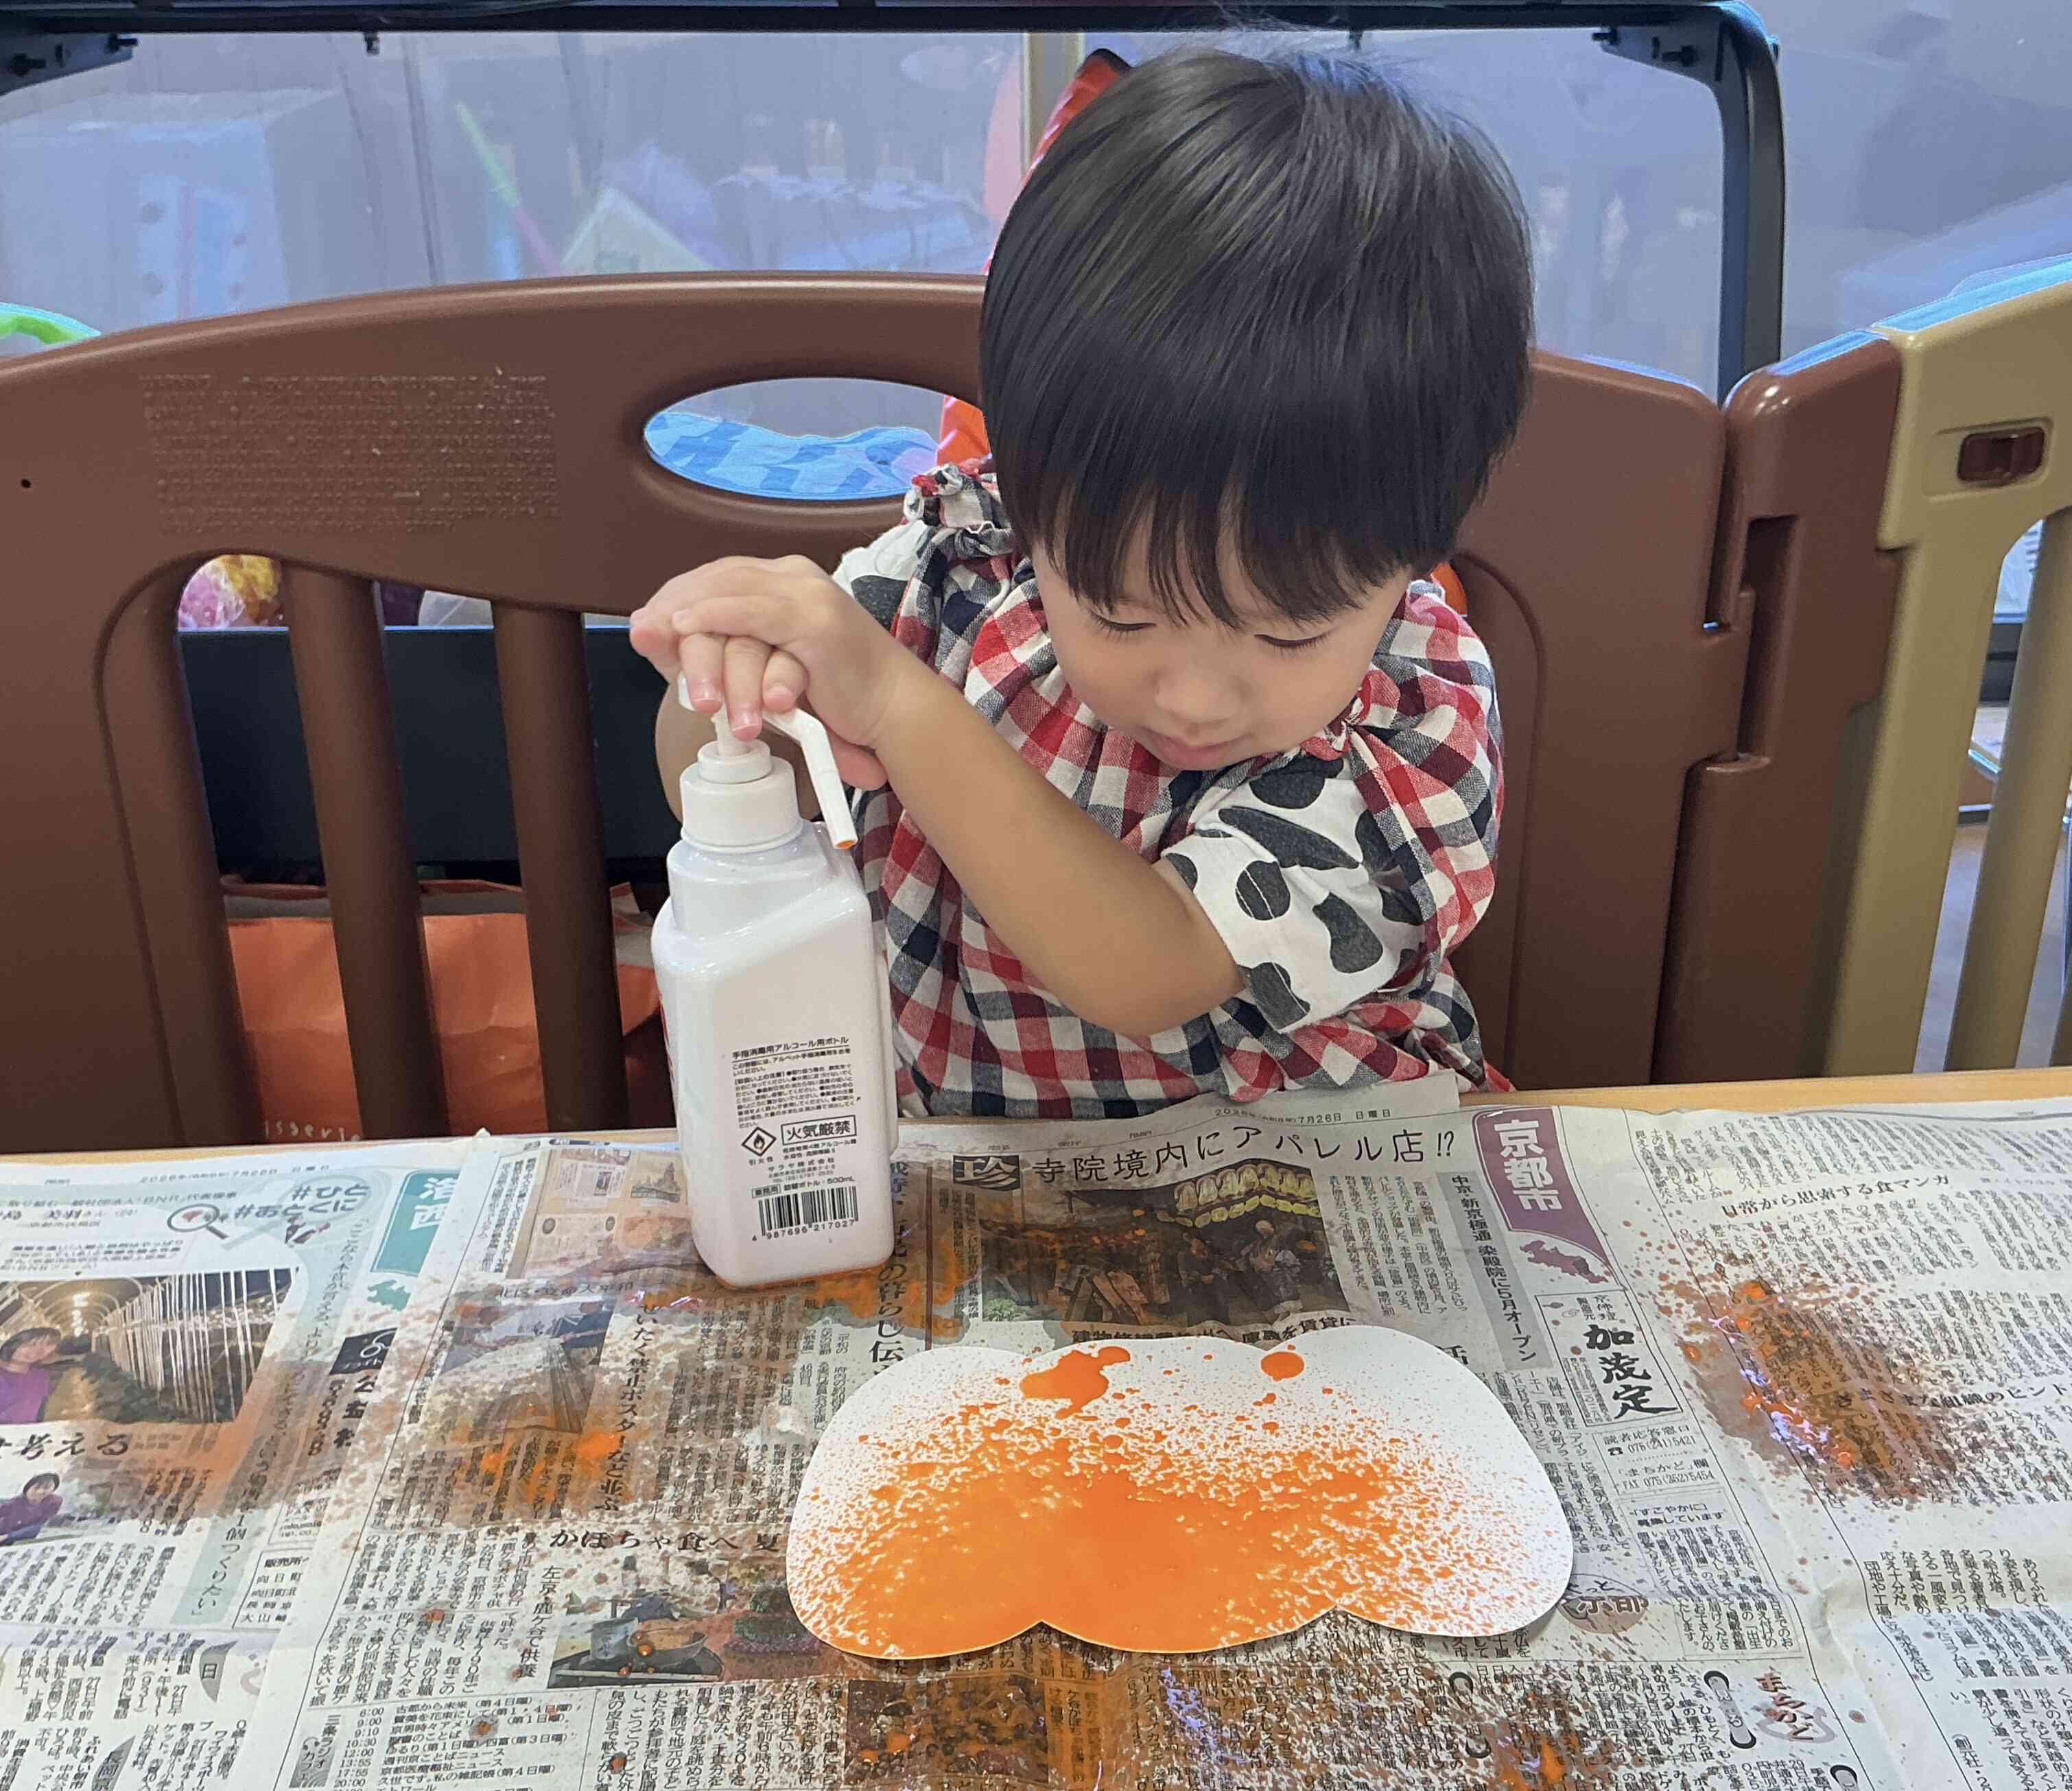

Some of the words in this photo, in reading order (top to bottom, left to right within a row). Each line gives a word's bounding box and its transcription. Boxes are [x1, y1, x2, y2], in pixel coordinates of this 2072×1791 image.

[732, 1036, 849, 1060] 手指消毒用アルコール用ボトル
[1355, 1108, 1392, 1120] 日曜日
[787, 1120, 851, 1141] 火気厳禁
[1494, 1119, 1564, 1211] 京都市
[292, 1183, 371, 1200] #ひと
[1721, 1174, 1950, 1218] 日常から思索する食マンガ
[766, 1226, 808, 1240] 987696
[814, 1219, 855, 1232] 217027
[1477, 1244, 1538, 1362] 染殿院に5月オープン
[0, 1431, 130, 1461] 考える
[1627, 1434, 1697, 1454] 075(241)5421
[1622, 1478, 1640, 1491] FAX
[1643, 1469, 1715, 1488] 075(252)5454
[360, 1707, 384, 1718] 6:00
[357, 1717, 382, 1728] 9:00
[314, 1714, 342, 1768] 三条ラジオ
[354, 1727, 380, 1738] 9:10
[345, 1737, 377, 1748] 10:30
[343, 1748, 375, 1758] 12:00
[340, 1758, 372, 1768] 13:55
[336, 1768, 368, 1778] 17:55
[333, 1778, 366, 1788] 20:00
